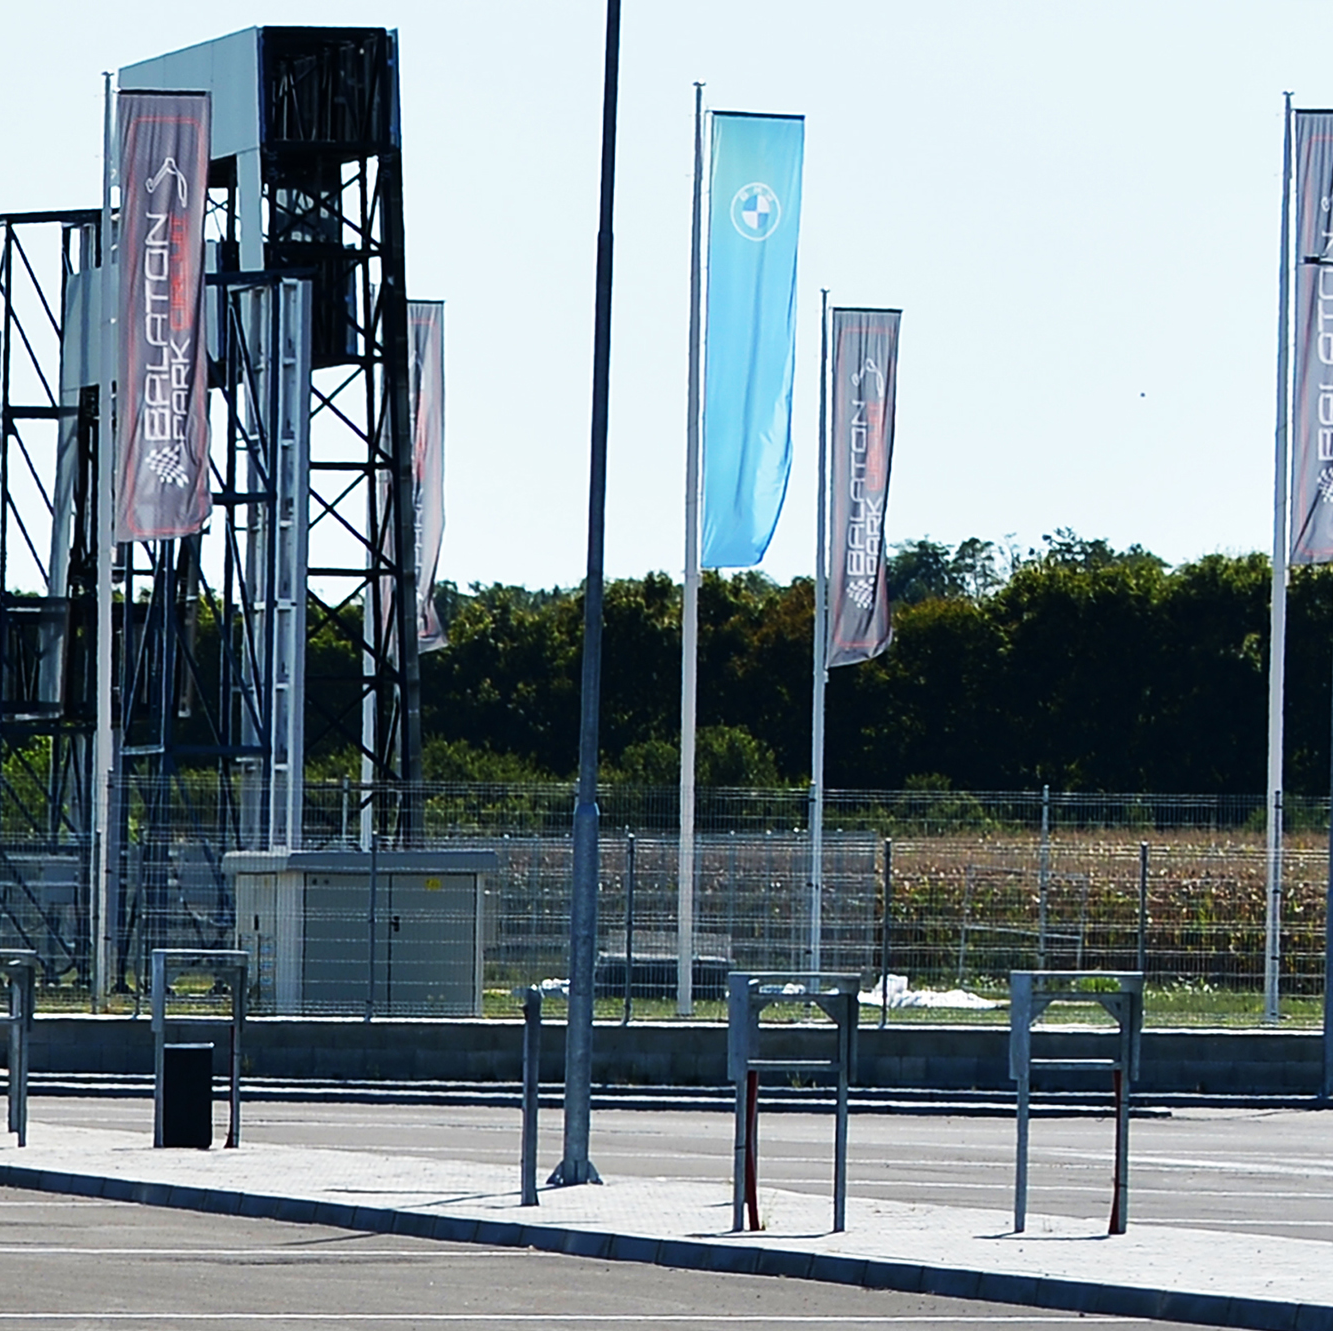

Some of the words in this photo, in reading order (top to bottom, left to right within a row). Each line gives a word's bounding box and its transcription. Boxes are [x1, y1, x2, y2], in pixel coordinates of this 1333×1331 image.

[145, 212, 170, 441] BALATON
[170, 338, 191, 440] PARK
[847, 400, 867, 576] BALATON
[865, 496, 883, 576] PARK
